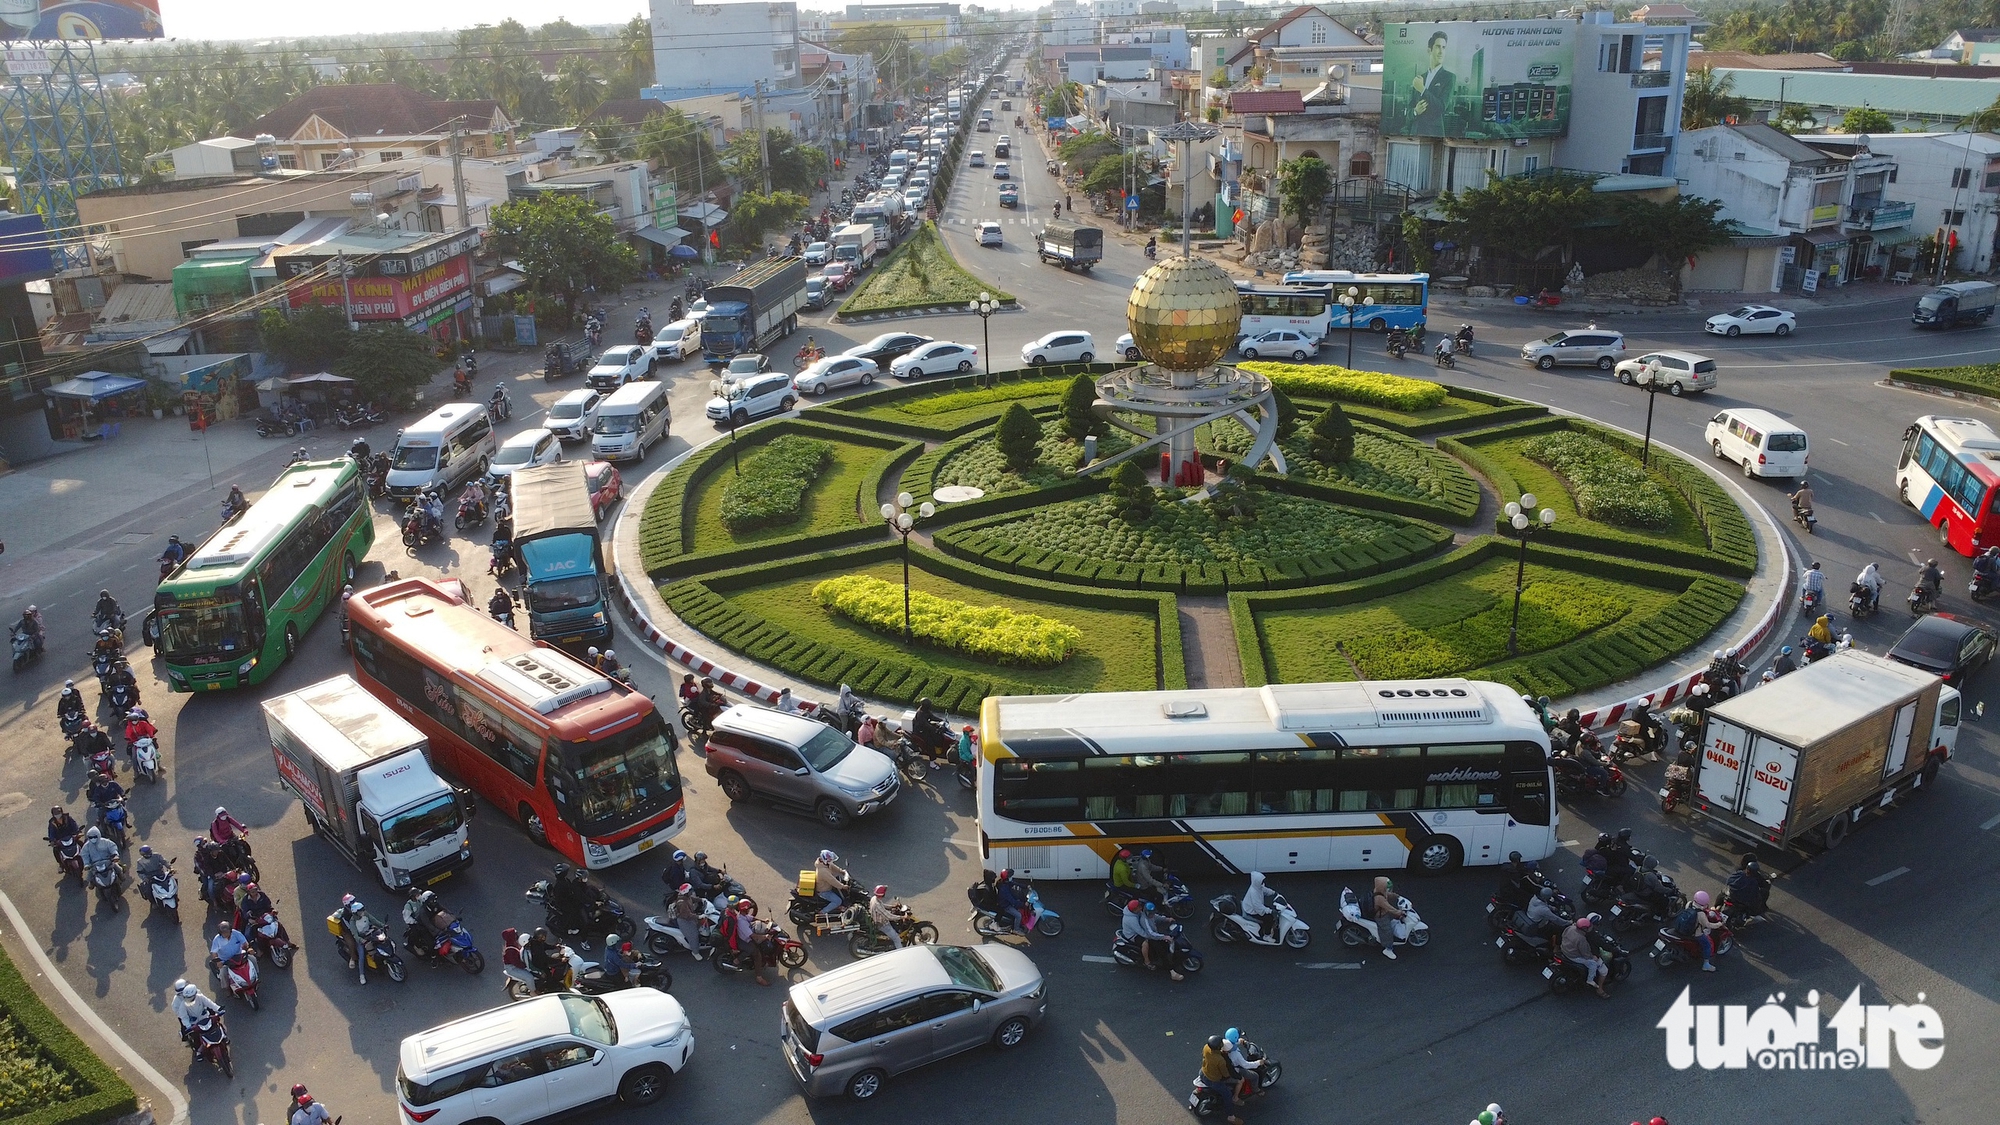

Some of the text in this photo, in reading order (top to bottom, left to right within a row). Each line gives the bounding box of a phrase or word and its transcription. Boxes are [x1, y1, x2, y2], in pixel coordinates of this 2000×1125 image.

[412, 292, 425, 307] BV.
[453, 268, 466, 288] PHỦ
[350, 299, 396, 316] BIÊN PHỦ
[544, 560, 576, 572] JAC
[1714, 738, 1736, 756] 71H
[1706, 750, 1739, 771] 040.92
[382, 764, 411, 779] ISUZU
[1427, 767, 1501, 782] mobihome
[1754, 769, 1789, 792] ISUZU
